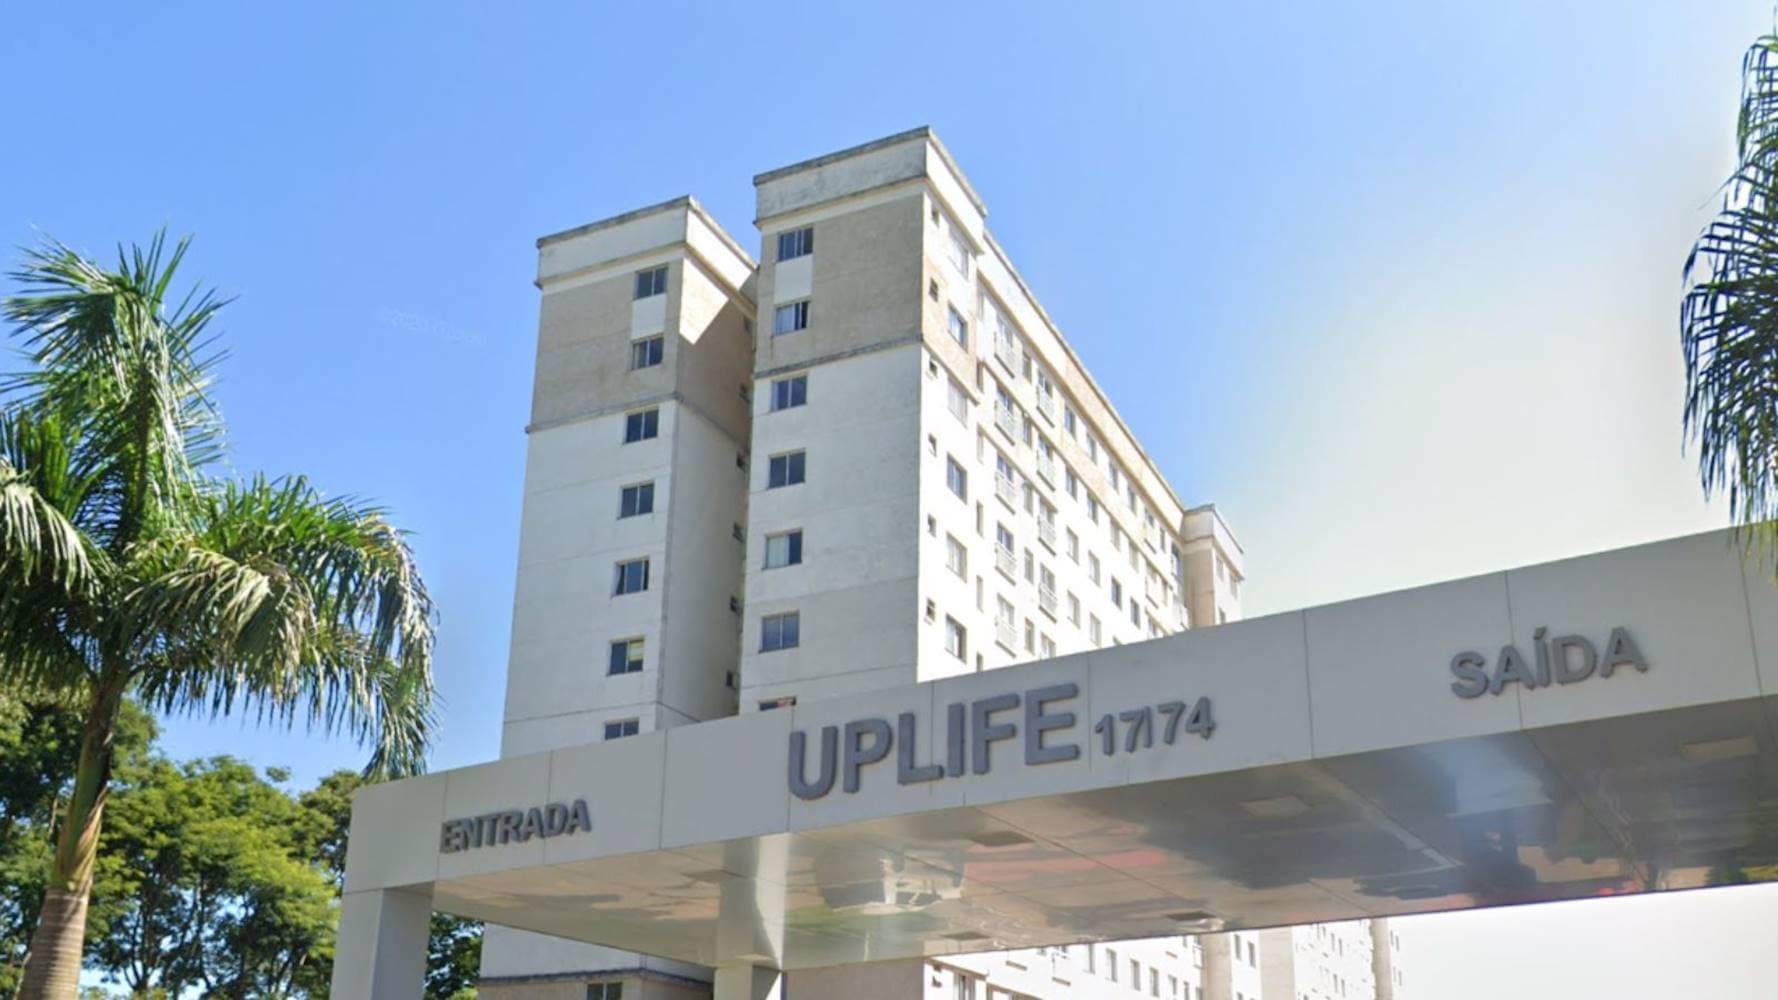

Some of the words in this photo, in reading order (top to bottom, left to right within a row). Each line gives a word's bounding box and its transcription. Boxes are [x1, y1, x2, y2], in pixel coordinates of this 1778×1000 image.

[1451, 626, 1649, 699] SAÍDA
[787, 682, 1080, 800] UPLIFE
[1094, 696, 1216, 757] 17174
[440, 799, 591, 853] ENTRADA
